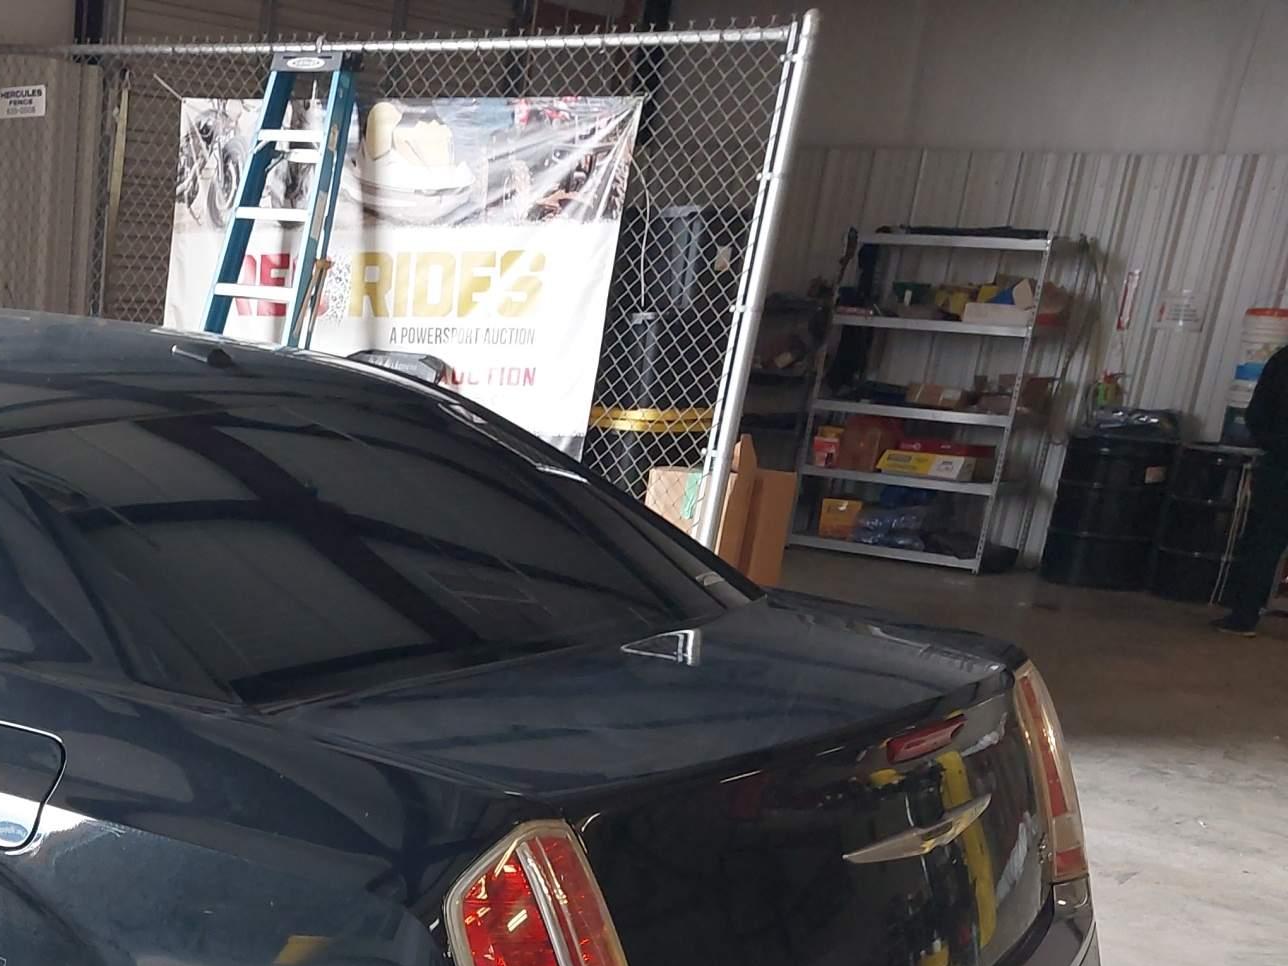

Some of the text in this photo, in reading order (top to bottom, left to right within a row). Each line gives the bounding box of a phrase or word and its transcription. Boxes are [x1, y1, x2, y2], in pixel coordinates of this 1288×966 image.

[0, 89, 43, 99] HERCULES
[8, 99, 33, 107] FENCE
[389, 326, 536, 345] A POWERSPORT AUCTION
